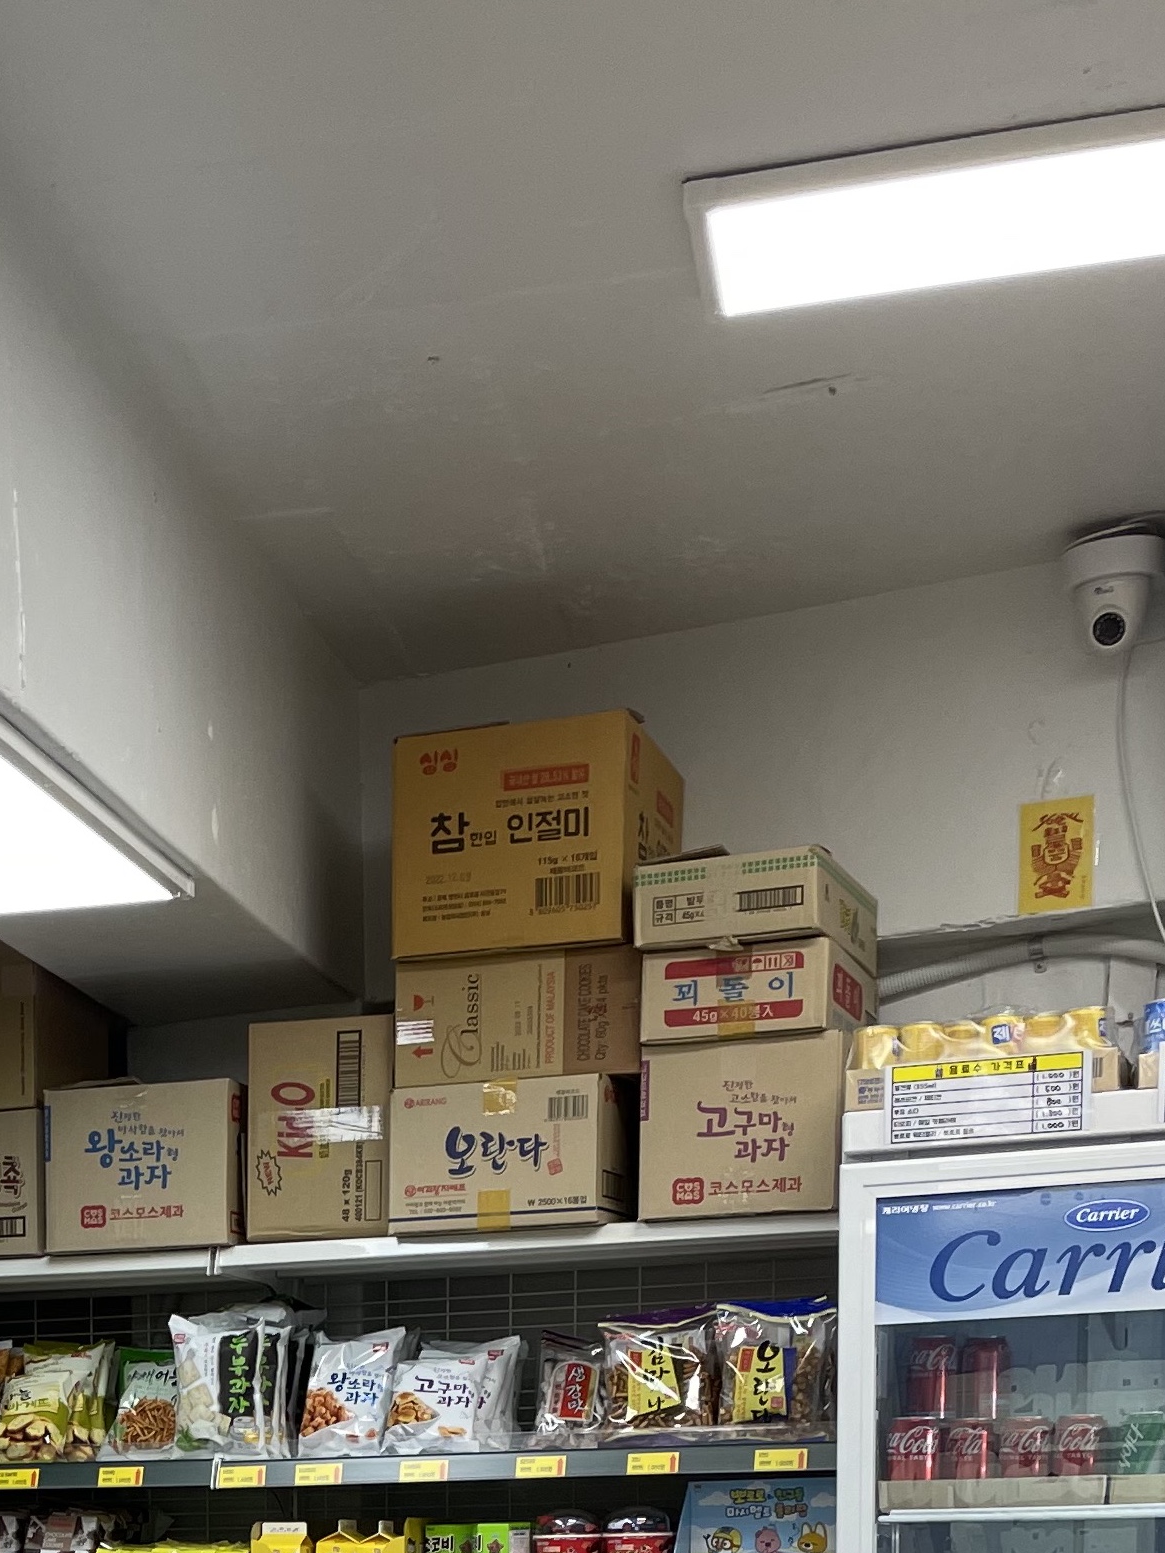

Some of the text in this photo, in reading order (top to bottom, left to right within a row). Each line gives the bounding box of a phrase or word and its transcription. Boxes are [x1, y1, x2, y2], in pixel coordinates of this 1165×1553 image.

[430, 806, 590, 854] 참 한입 인절미
[441, 972, 483, 1079] Classic
[543, 971, 556, 1065] PRODUCT OF MALAYSIA
[575, 963, 592, 1062] CHOCOLATE COOKIES
[949, 1063, 982, 1075] 음료수
[445, 1126, 549, 1178] 오란다
[734, 1136, 790, 1163] 과자
[118, 1164, 172, 1191] 과자
[341, 1168, 352, 1223] 48 120g
[708, 1176, 803, 1197] 코스모스제과
[110, 1205, 184, 1221] 코스모스제과
[1074, 1206, 1140, 1223] Carrier
[929, 1230, 1165, 1303] Carri
[227, 1335, 252, 1416] 두부과자
[344, 1391, 380, 1407] 과자
[436, 1395, 473, 1409] 과자
